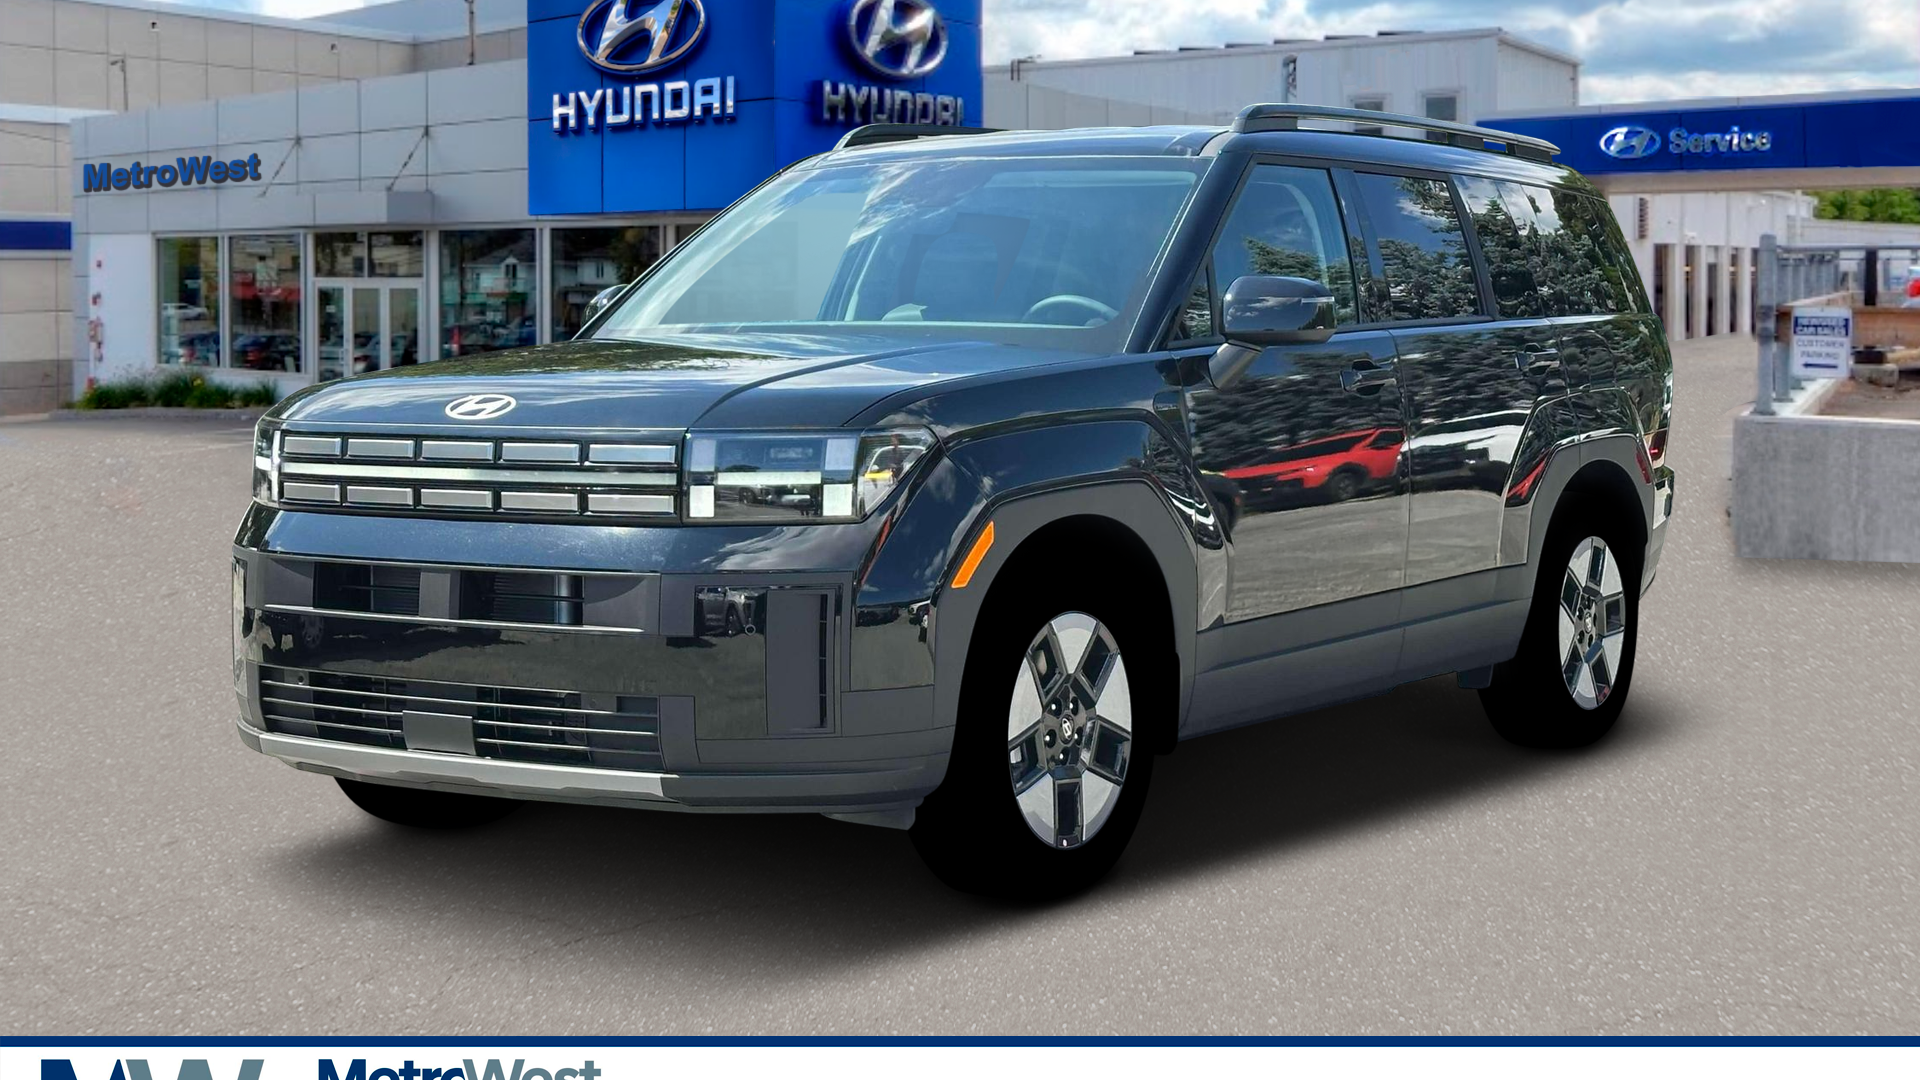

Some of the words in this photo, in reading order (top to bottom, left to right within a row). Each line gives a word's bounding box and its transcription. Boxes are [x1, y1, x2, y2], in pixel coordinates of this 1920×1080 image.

[552, 76, 735, 131] HYUNDAI
[823, 79, 965, 126] HYUNDAI
[1669, 126, 1771, 154] Service
[83, 153, 262, 192] MetroWest
[1796, 339, 1845, 348] CUSTOMER
[1800, 350, 1840, 360] PARKING
